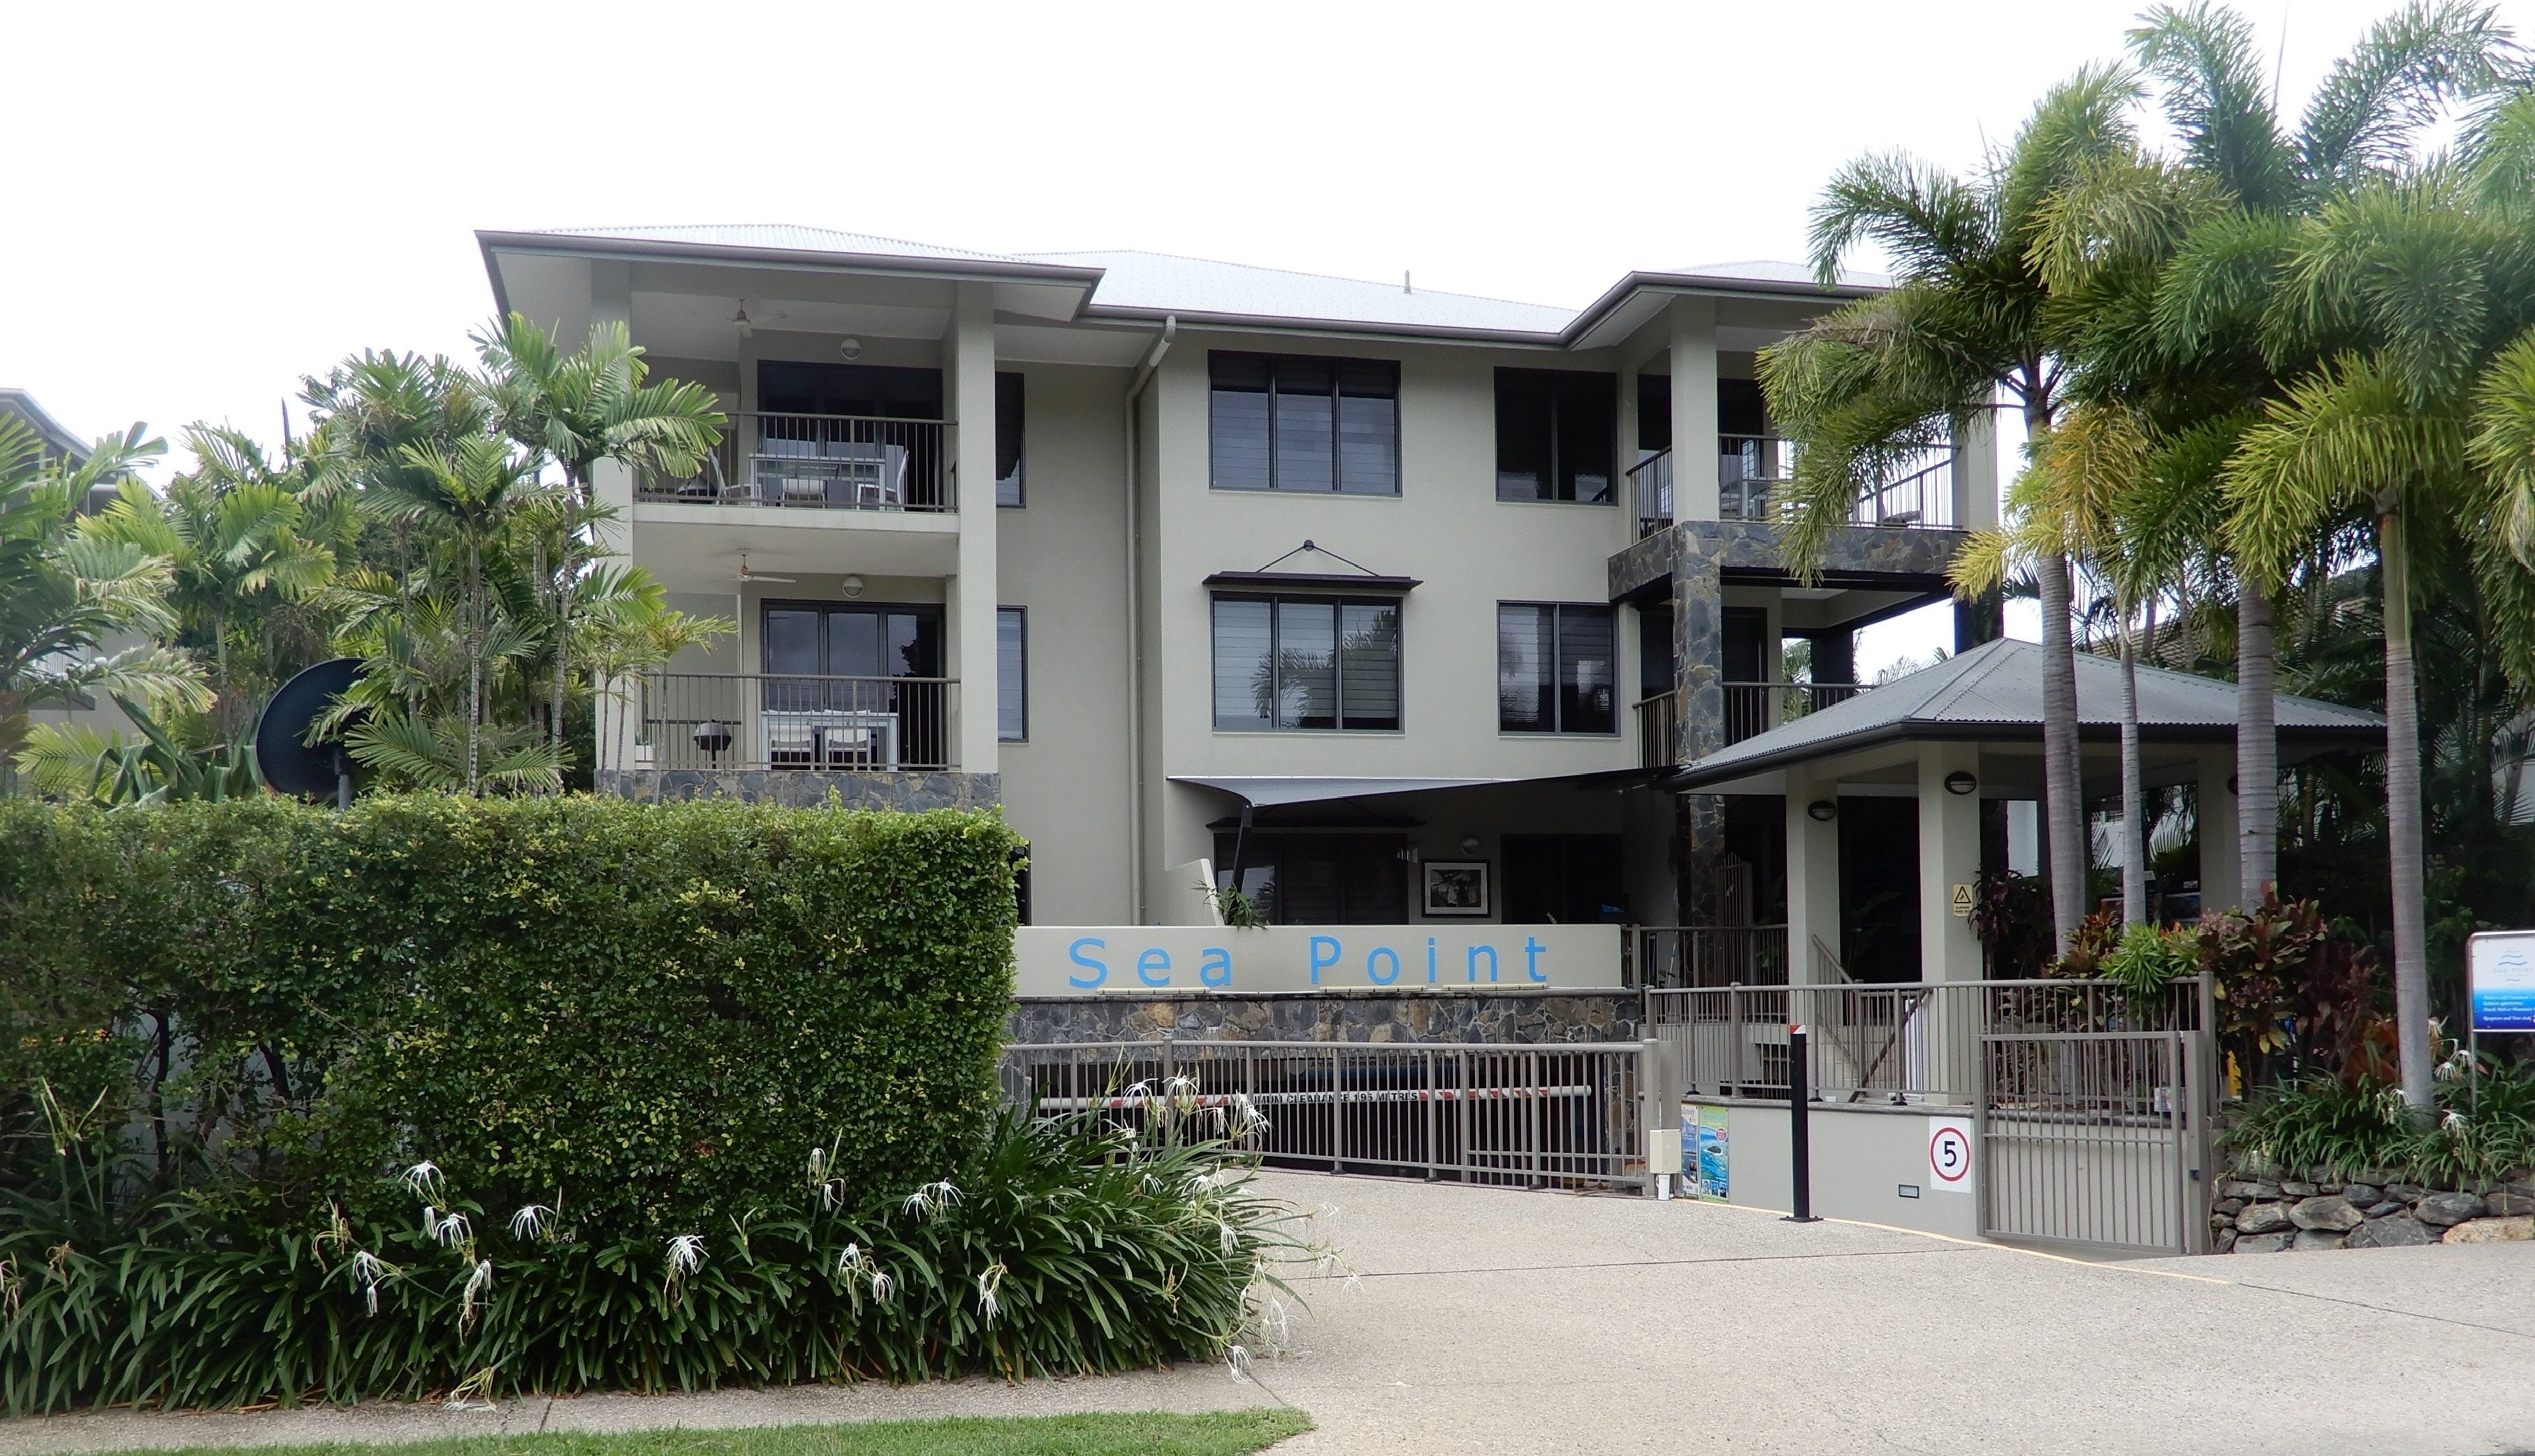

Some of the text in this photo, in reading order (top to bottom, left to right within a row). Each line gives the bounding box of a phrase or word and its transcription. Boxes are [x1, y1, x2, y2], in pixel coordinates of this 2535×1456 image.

[1069, 936, 1547, 988] Sea Point
[1230, 1094, 1283, 1105] MIMUM
[1376, 1092, 1418, 1101] METRES
[1944, 1140, 1957, 1167] 5
